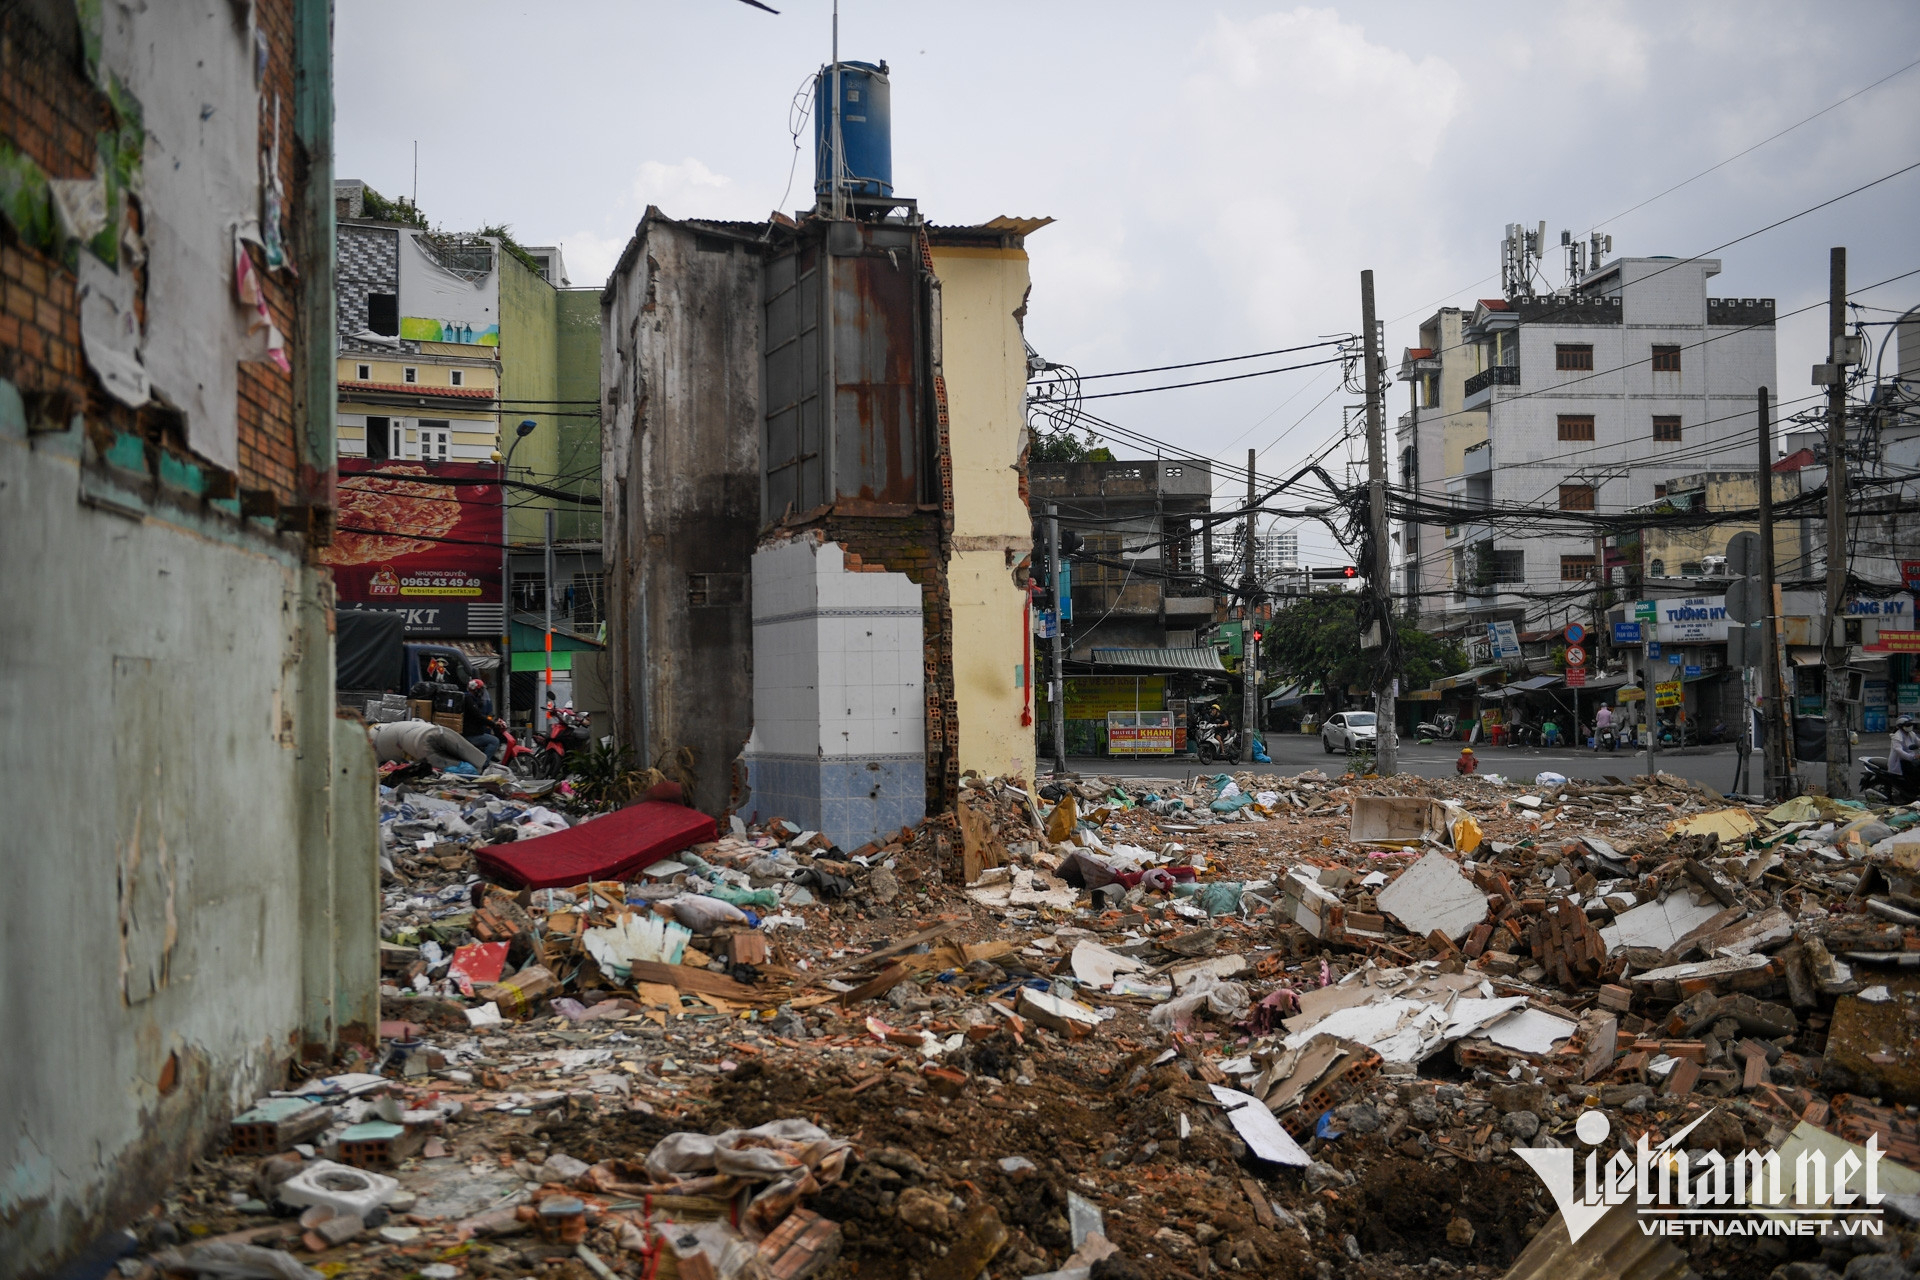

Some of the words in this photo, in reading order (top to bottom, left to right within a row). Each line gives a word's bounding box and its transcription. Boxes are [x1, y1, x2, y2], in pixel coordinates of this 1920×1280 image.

[400, 577, 430, 586] 0963
[432, 578, 447, 586] 43
[449, 578, 464, 587] 49
[466, 578, 481, 587] 49
[373, 585, 396, 593] FKT
[1883, 601, 1904, 614] HY
[1666, 606, 1708, 622] TƯỜNG
[1709, 606, 1727, 620] HY
[1140, 728, 1172, 737] KHÁNH
